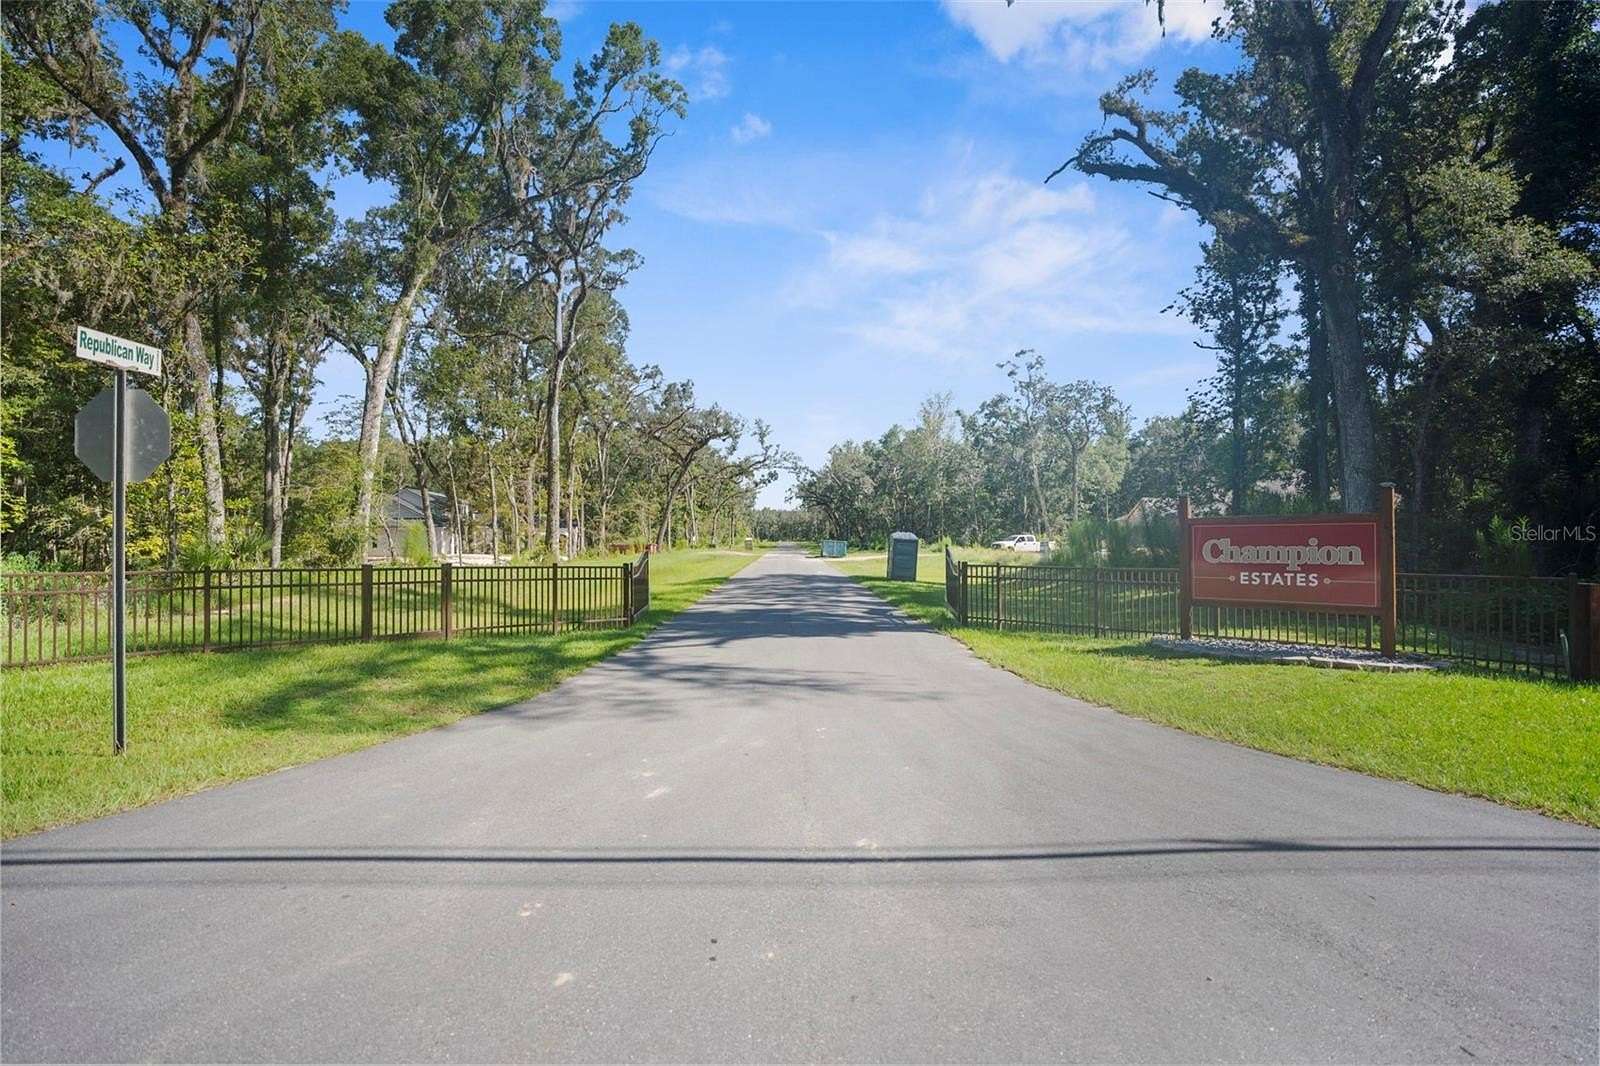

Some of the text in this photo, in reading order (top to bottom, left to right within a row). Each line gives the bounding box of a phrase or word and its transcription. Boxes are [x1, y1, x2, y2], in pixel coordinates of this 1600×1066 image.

[79, 330, 134, 361] Republican
[135, 345, 154, 370] Way
[1202, 537, 1364, 571] Champion
[1239, 572, 1319, 587] ESTATES
